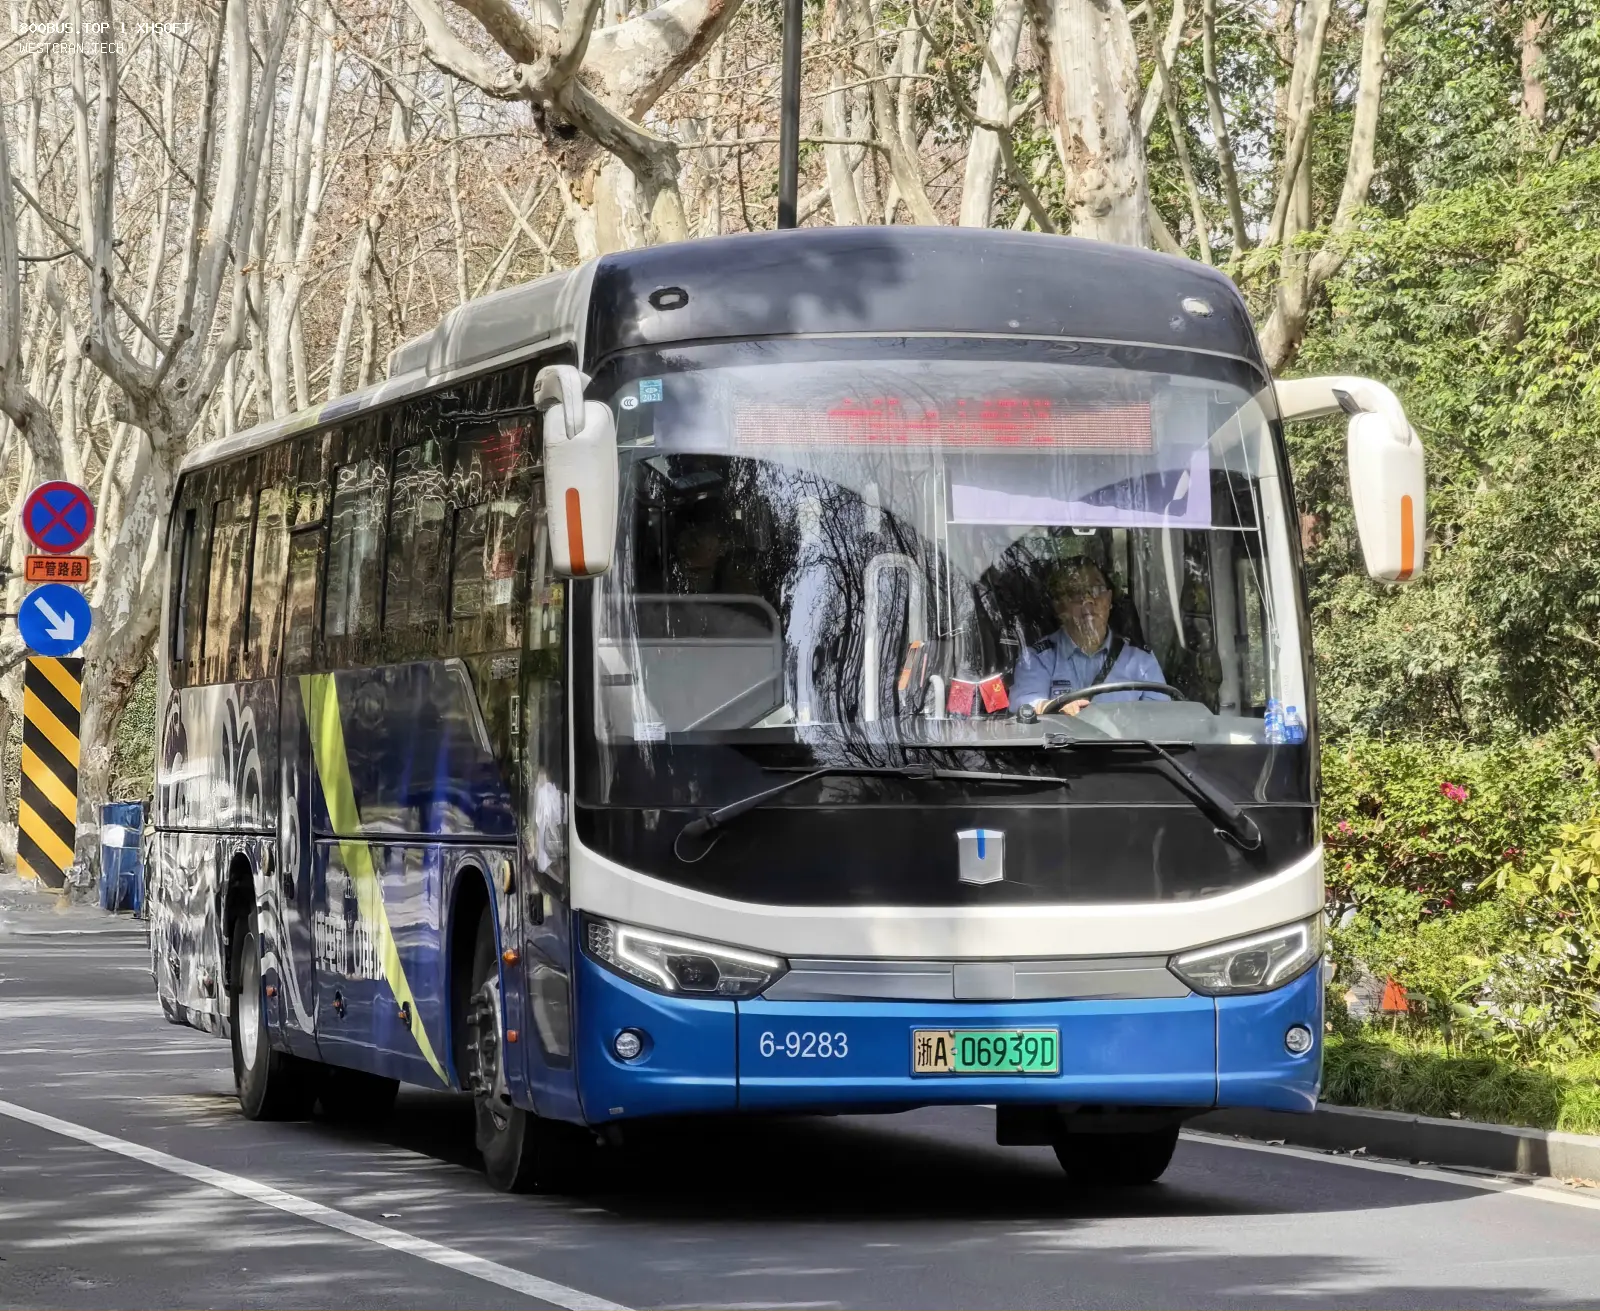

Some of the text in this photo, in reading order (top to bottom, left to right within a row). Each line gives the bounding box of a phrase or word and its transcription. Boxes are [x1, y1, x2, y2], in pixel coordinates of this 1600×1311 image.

[643, 393, 661, 402] 2021
[31, 561, 83, 577] 严管路段
[759, 1031, 849, 1058] 6-9283
